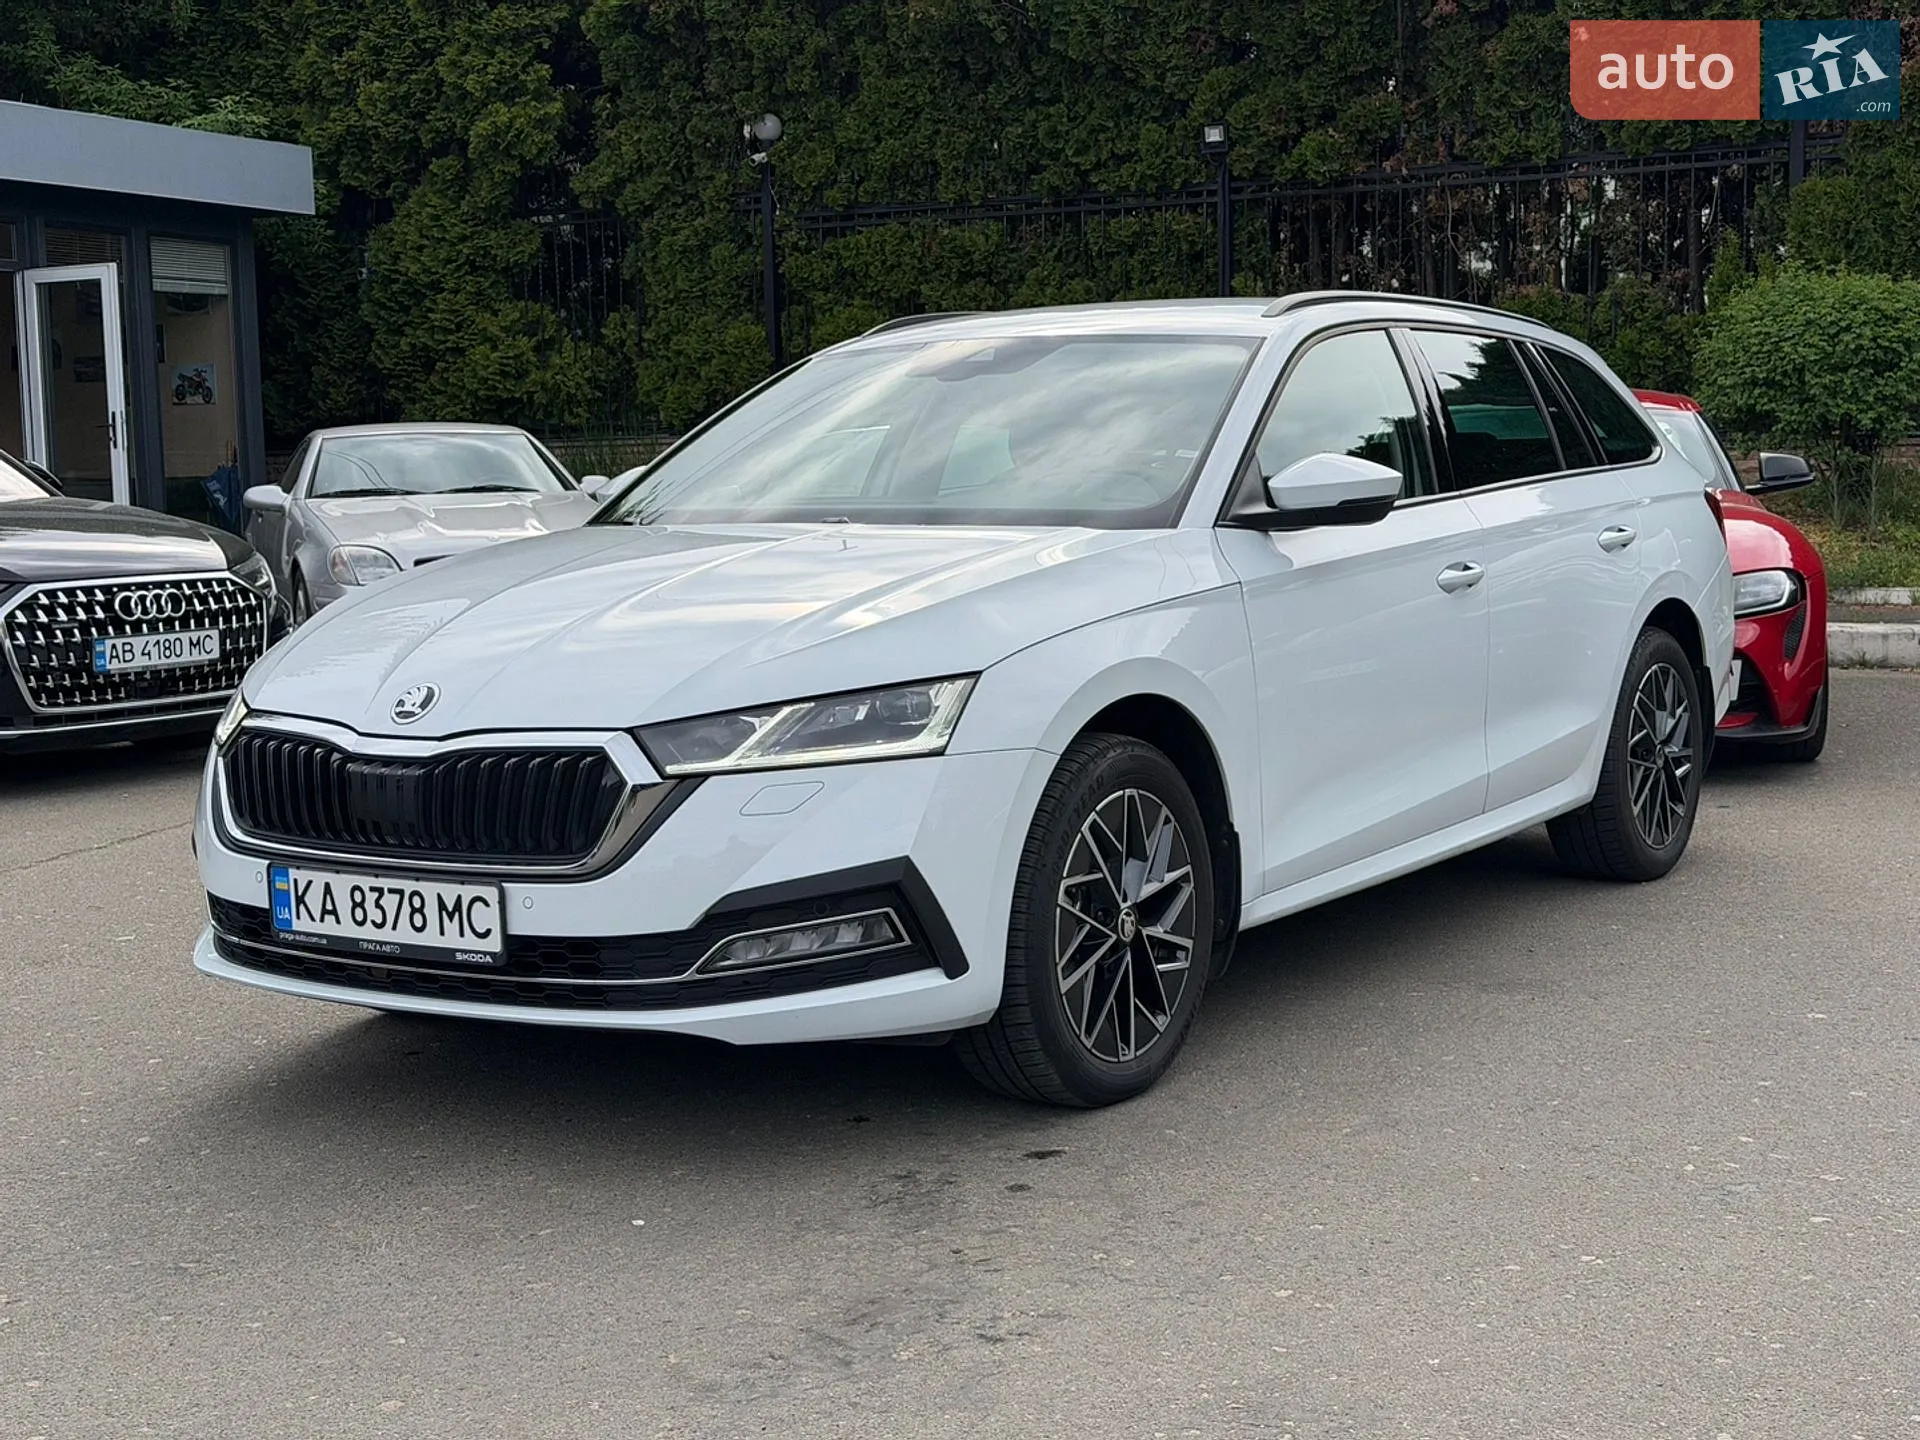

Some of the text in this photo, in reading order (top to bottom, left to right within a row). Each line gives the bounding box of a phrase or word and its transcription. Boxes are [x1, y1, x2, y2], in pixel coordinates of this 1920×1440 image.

[109, 634, 214, 665] AB 4180 MC
[277, 905, 291, 920] UA
[293, 877, 493, 939] KA 8378 MC
